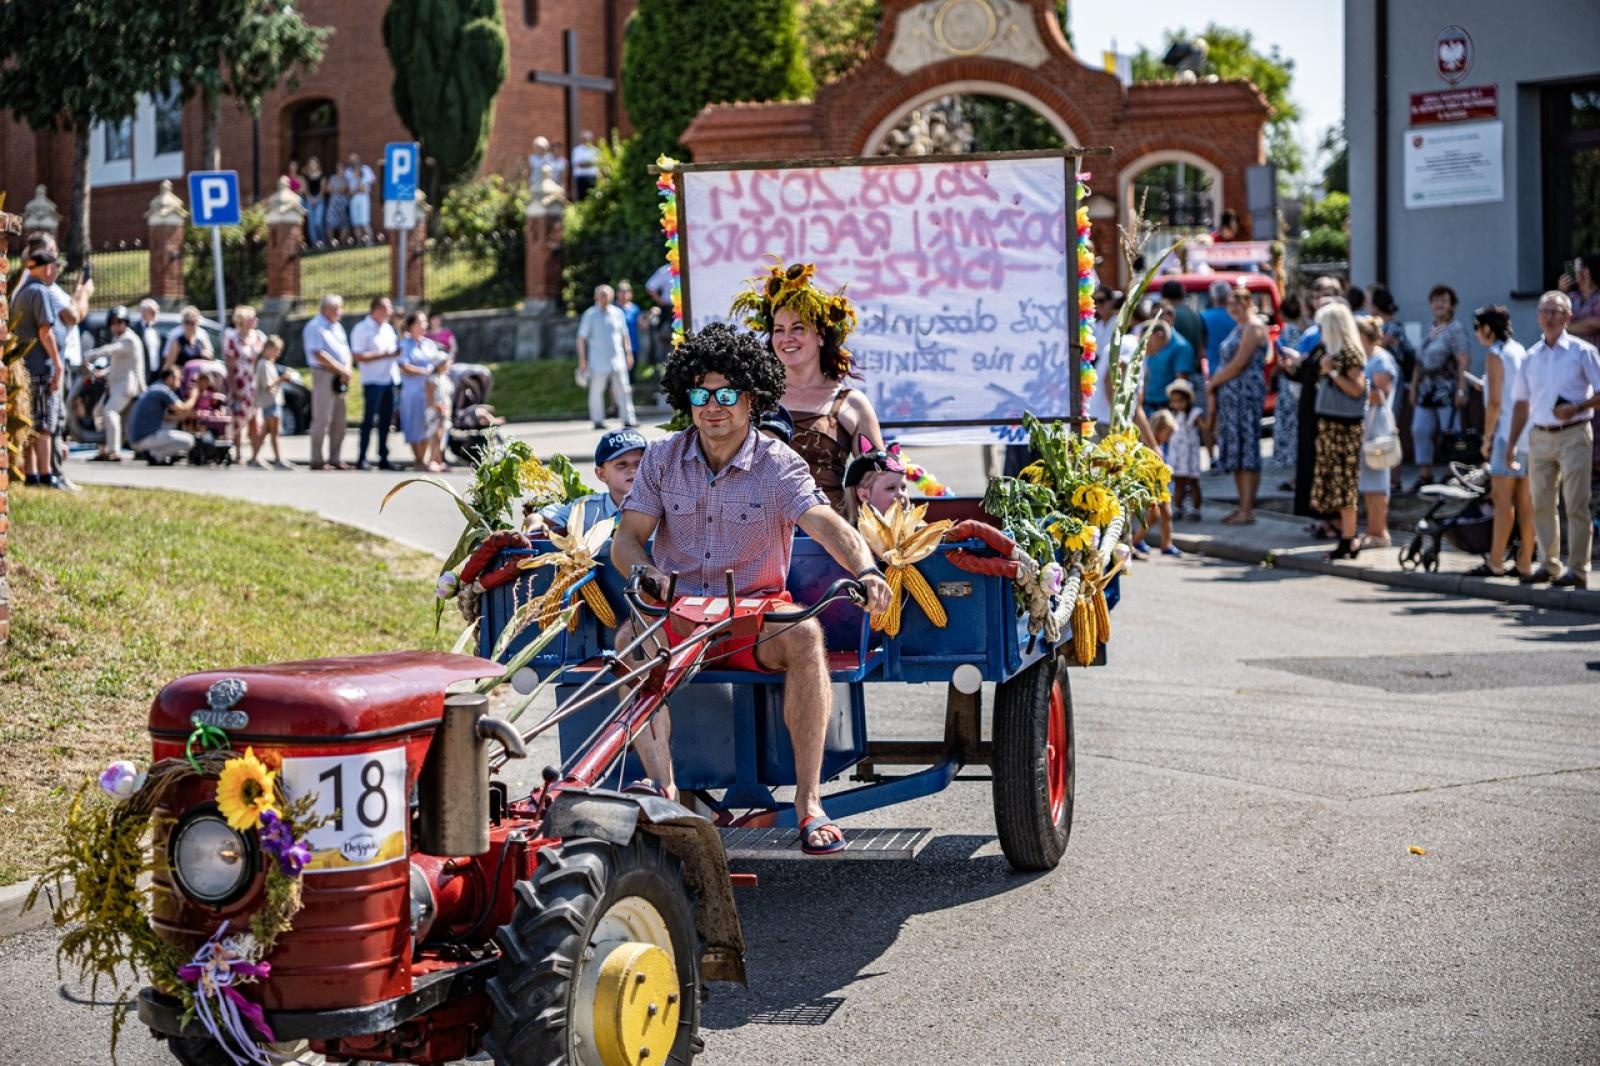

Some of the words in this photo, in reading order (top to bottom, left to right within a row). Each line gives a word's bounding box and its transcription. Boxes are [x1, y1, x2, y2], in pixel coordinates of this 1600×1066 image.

[391, 149, 411, 185] P
[201, 178, 229, 220] P
[319, 759, 388, 832] 18
